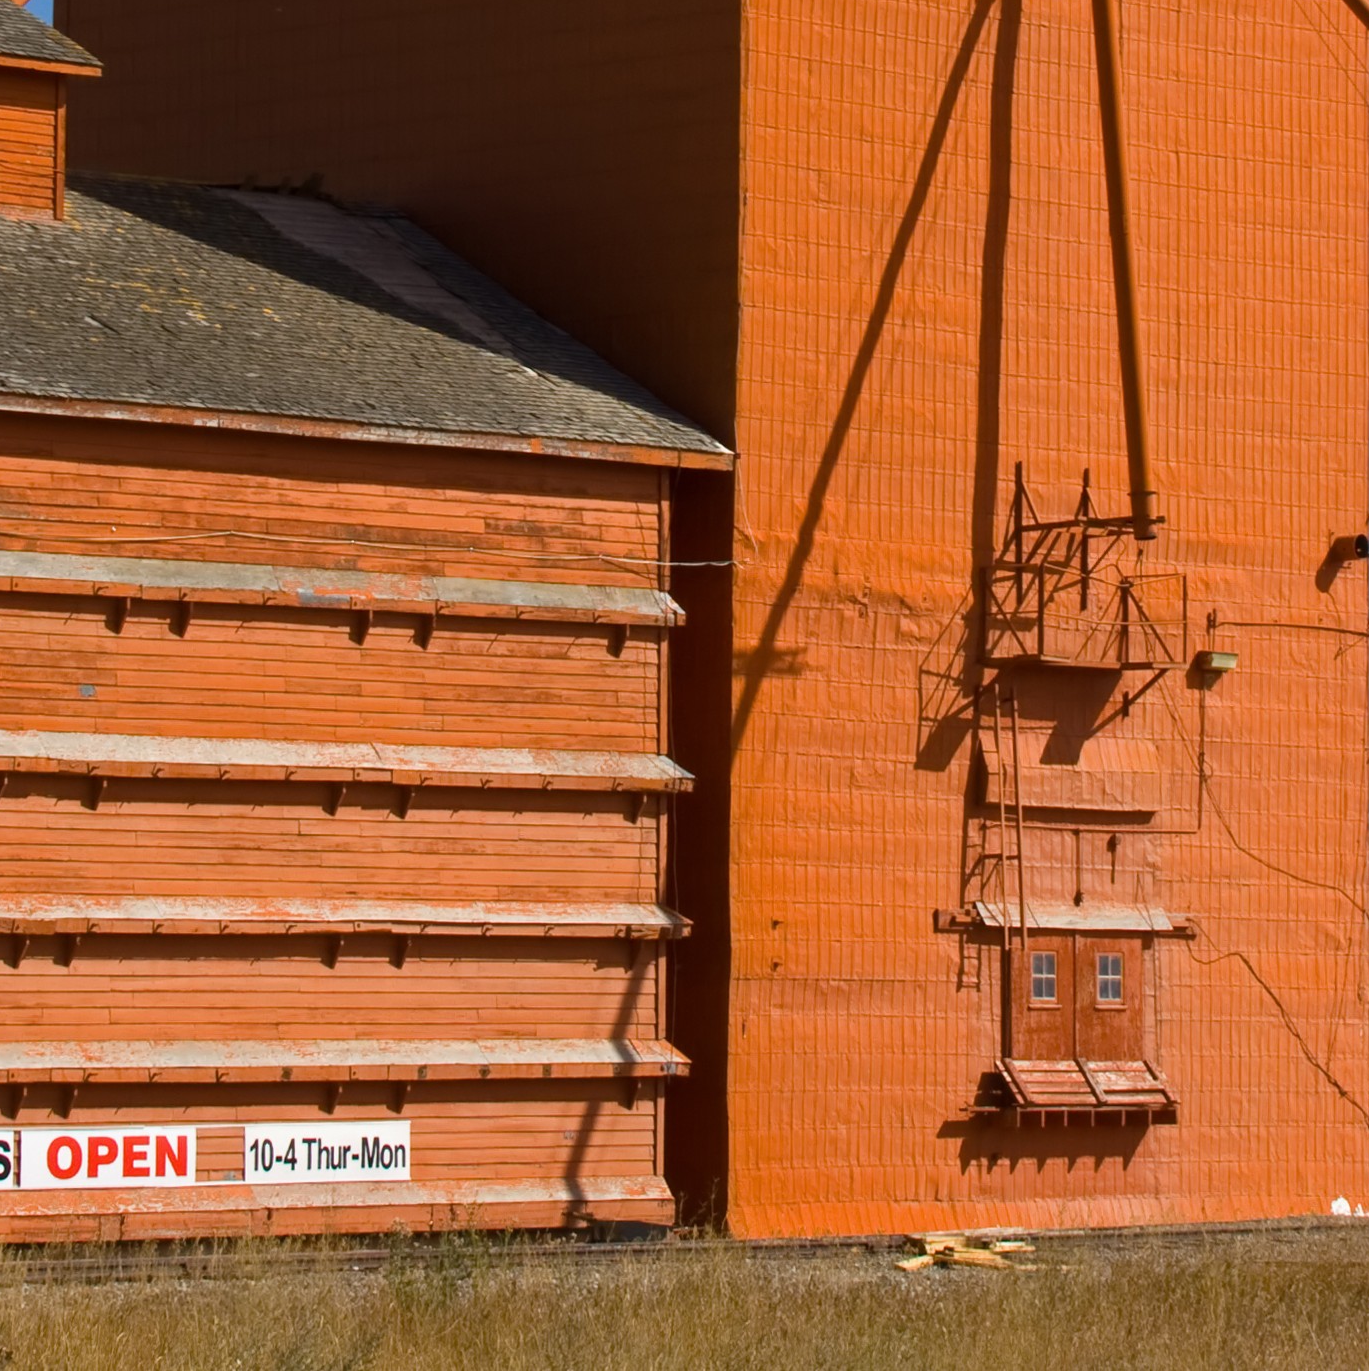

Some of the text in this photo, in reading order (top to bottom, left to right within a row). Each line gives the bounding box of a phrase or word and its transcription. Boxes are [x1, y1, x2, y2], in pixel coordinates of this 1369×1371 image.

[45, 1134, 188, 1180] OPEN
[249, 1135, 407, 1173] 10-4 Thur-Mon
